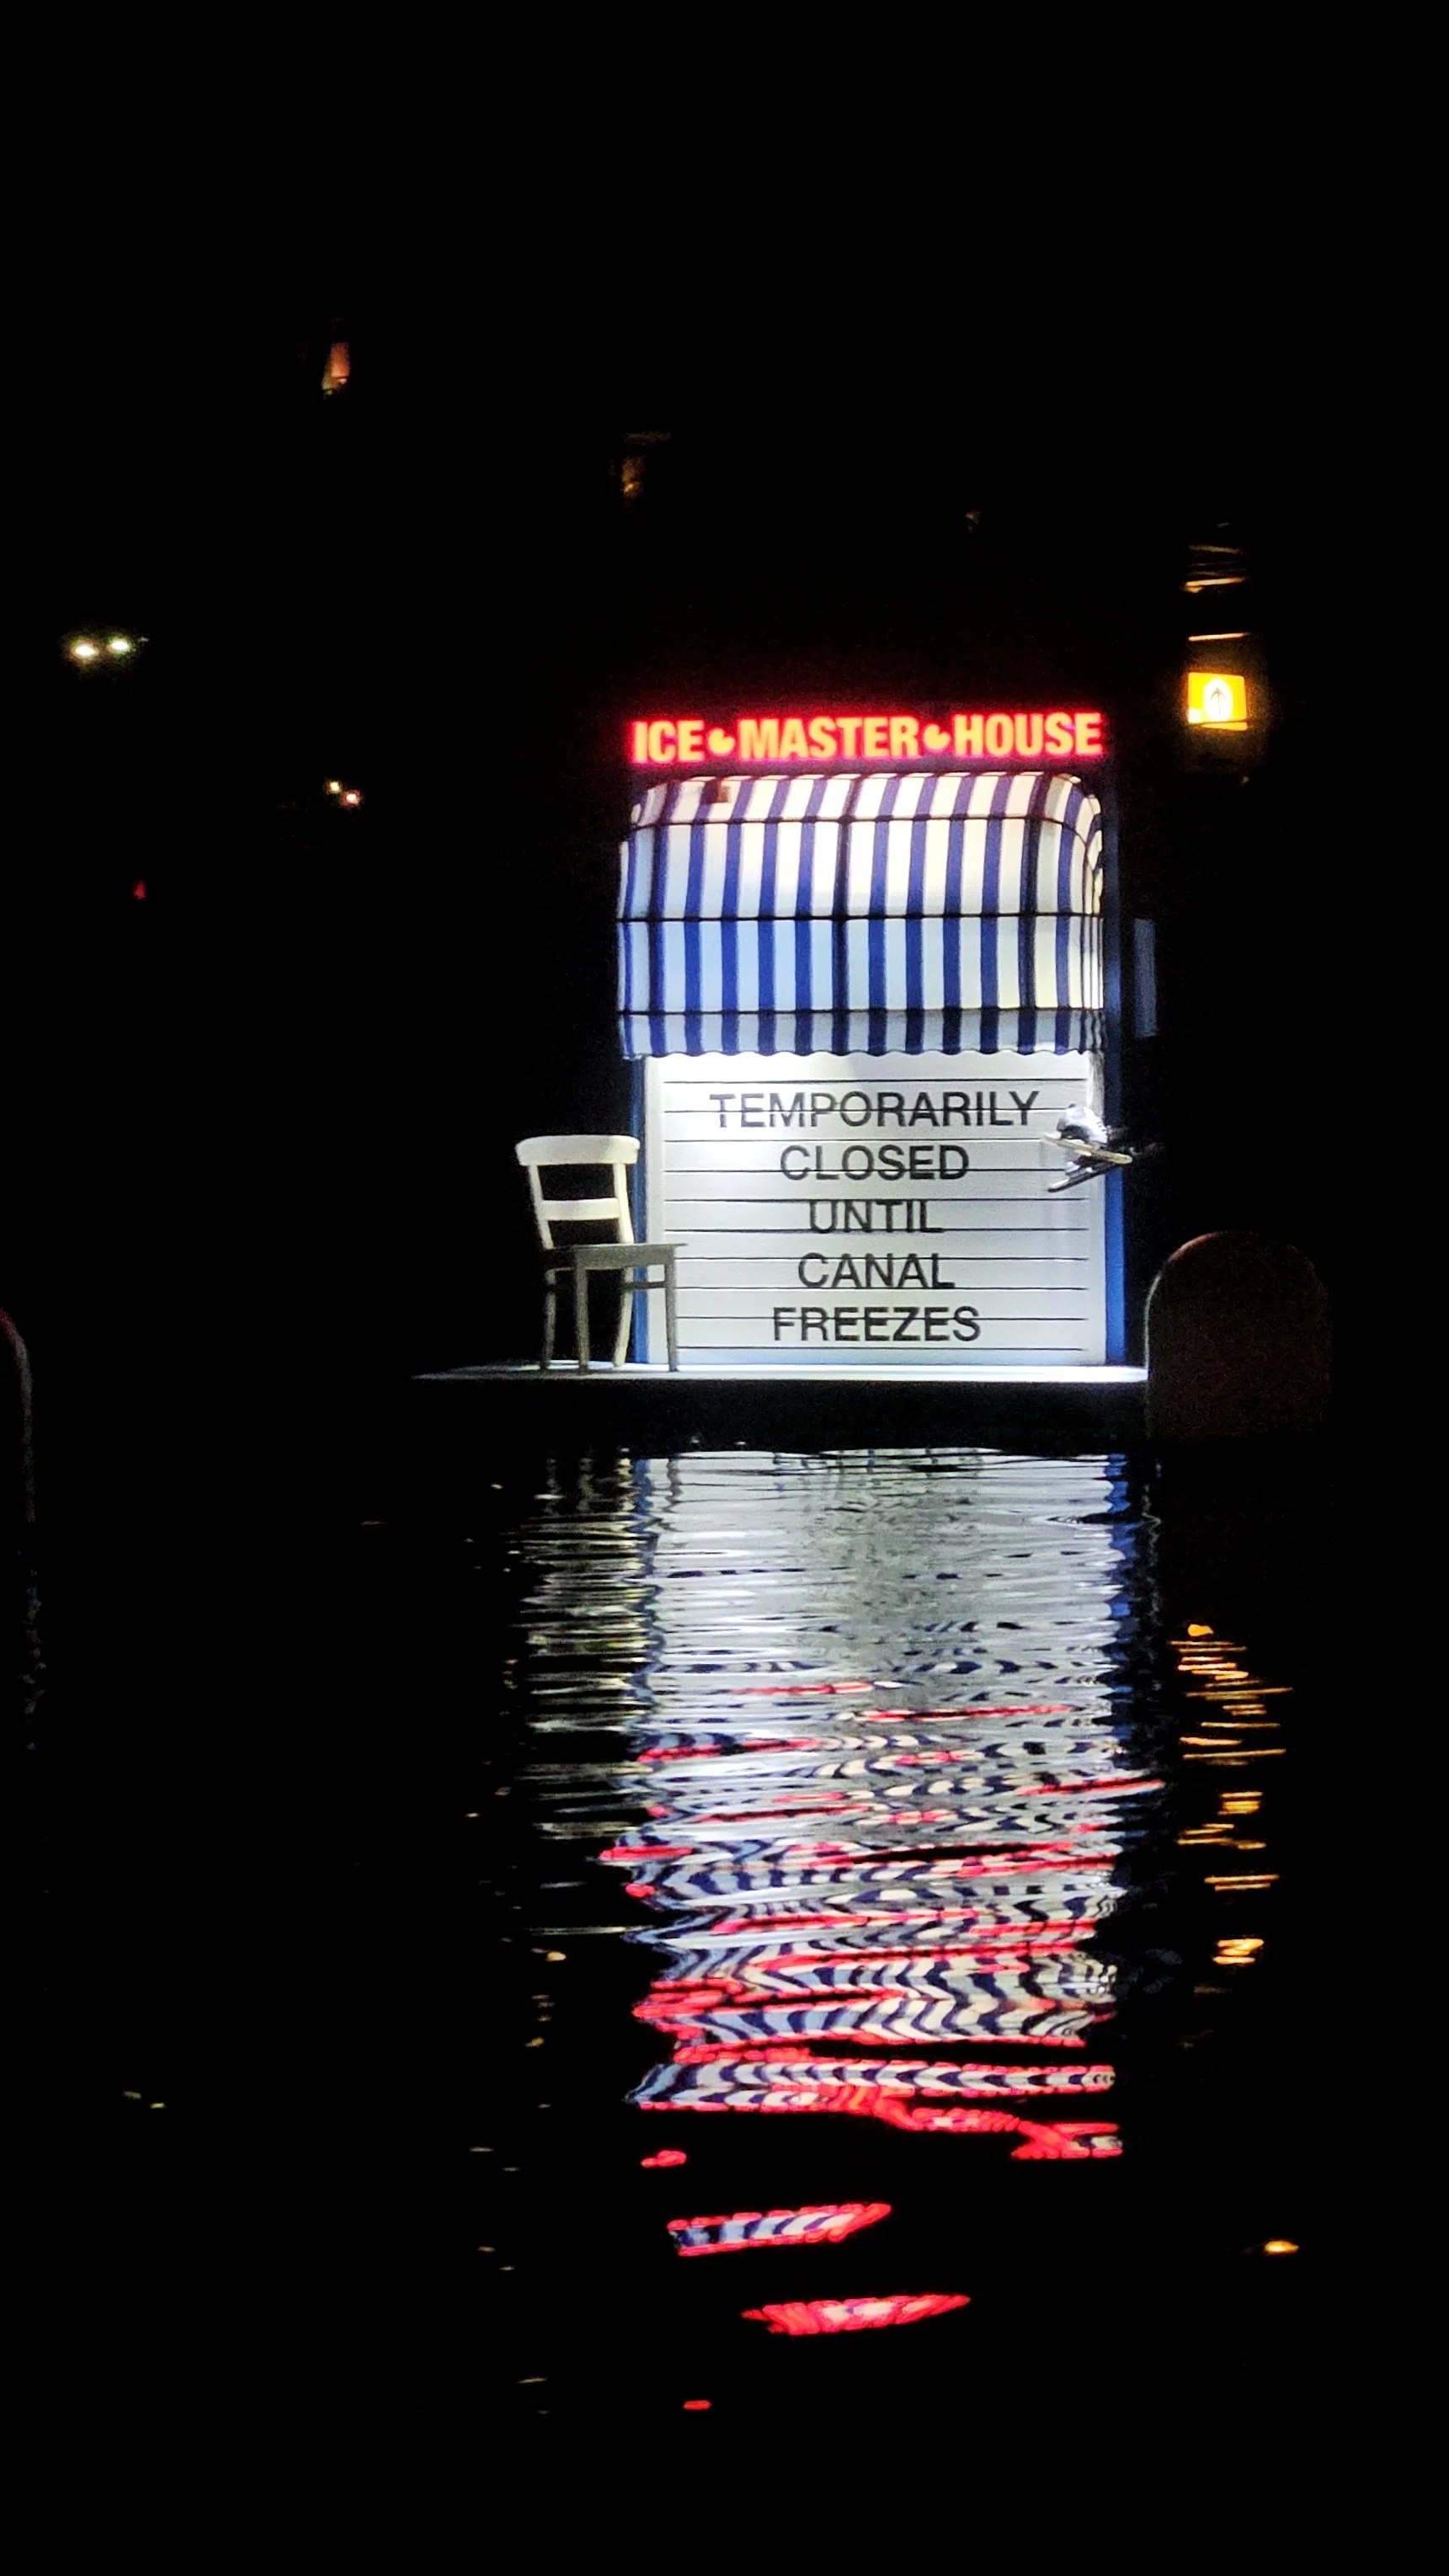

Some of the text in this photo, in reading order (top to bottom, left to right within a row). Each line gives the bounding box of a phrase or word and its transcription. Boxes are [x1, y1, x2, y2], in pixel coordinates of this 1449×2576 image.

[633, 712, 1103, 764] ICE MASTER HOUSE
[710, 1090, 1041, 1128] TEMPORARILY
[780, 1144, 969, 1181] CLOSED
[808, 1199, 944, 1234] UNTIL
[798, 1252, 956, 1289] CANAL
[773, 1305, 981, 1341] FREEZES
